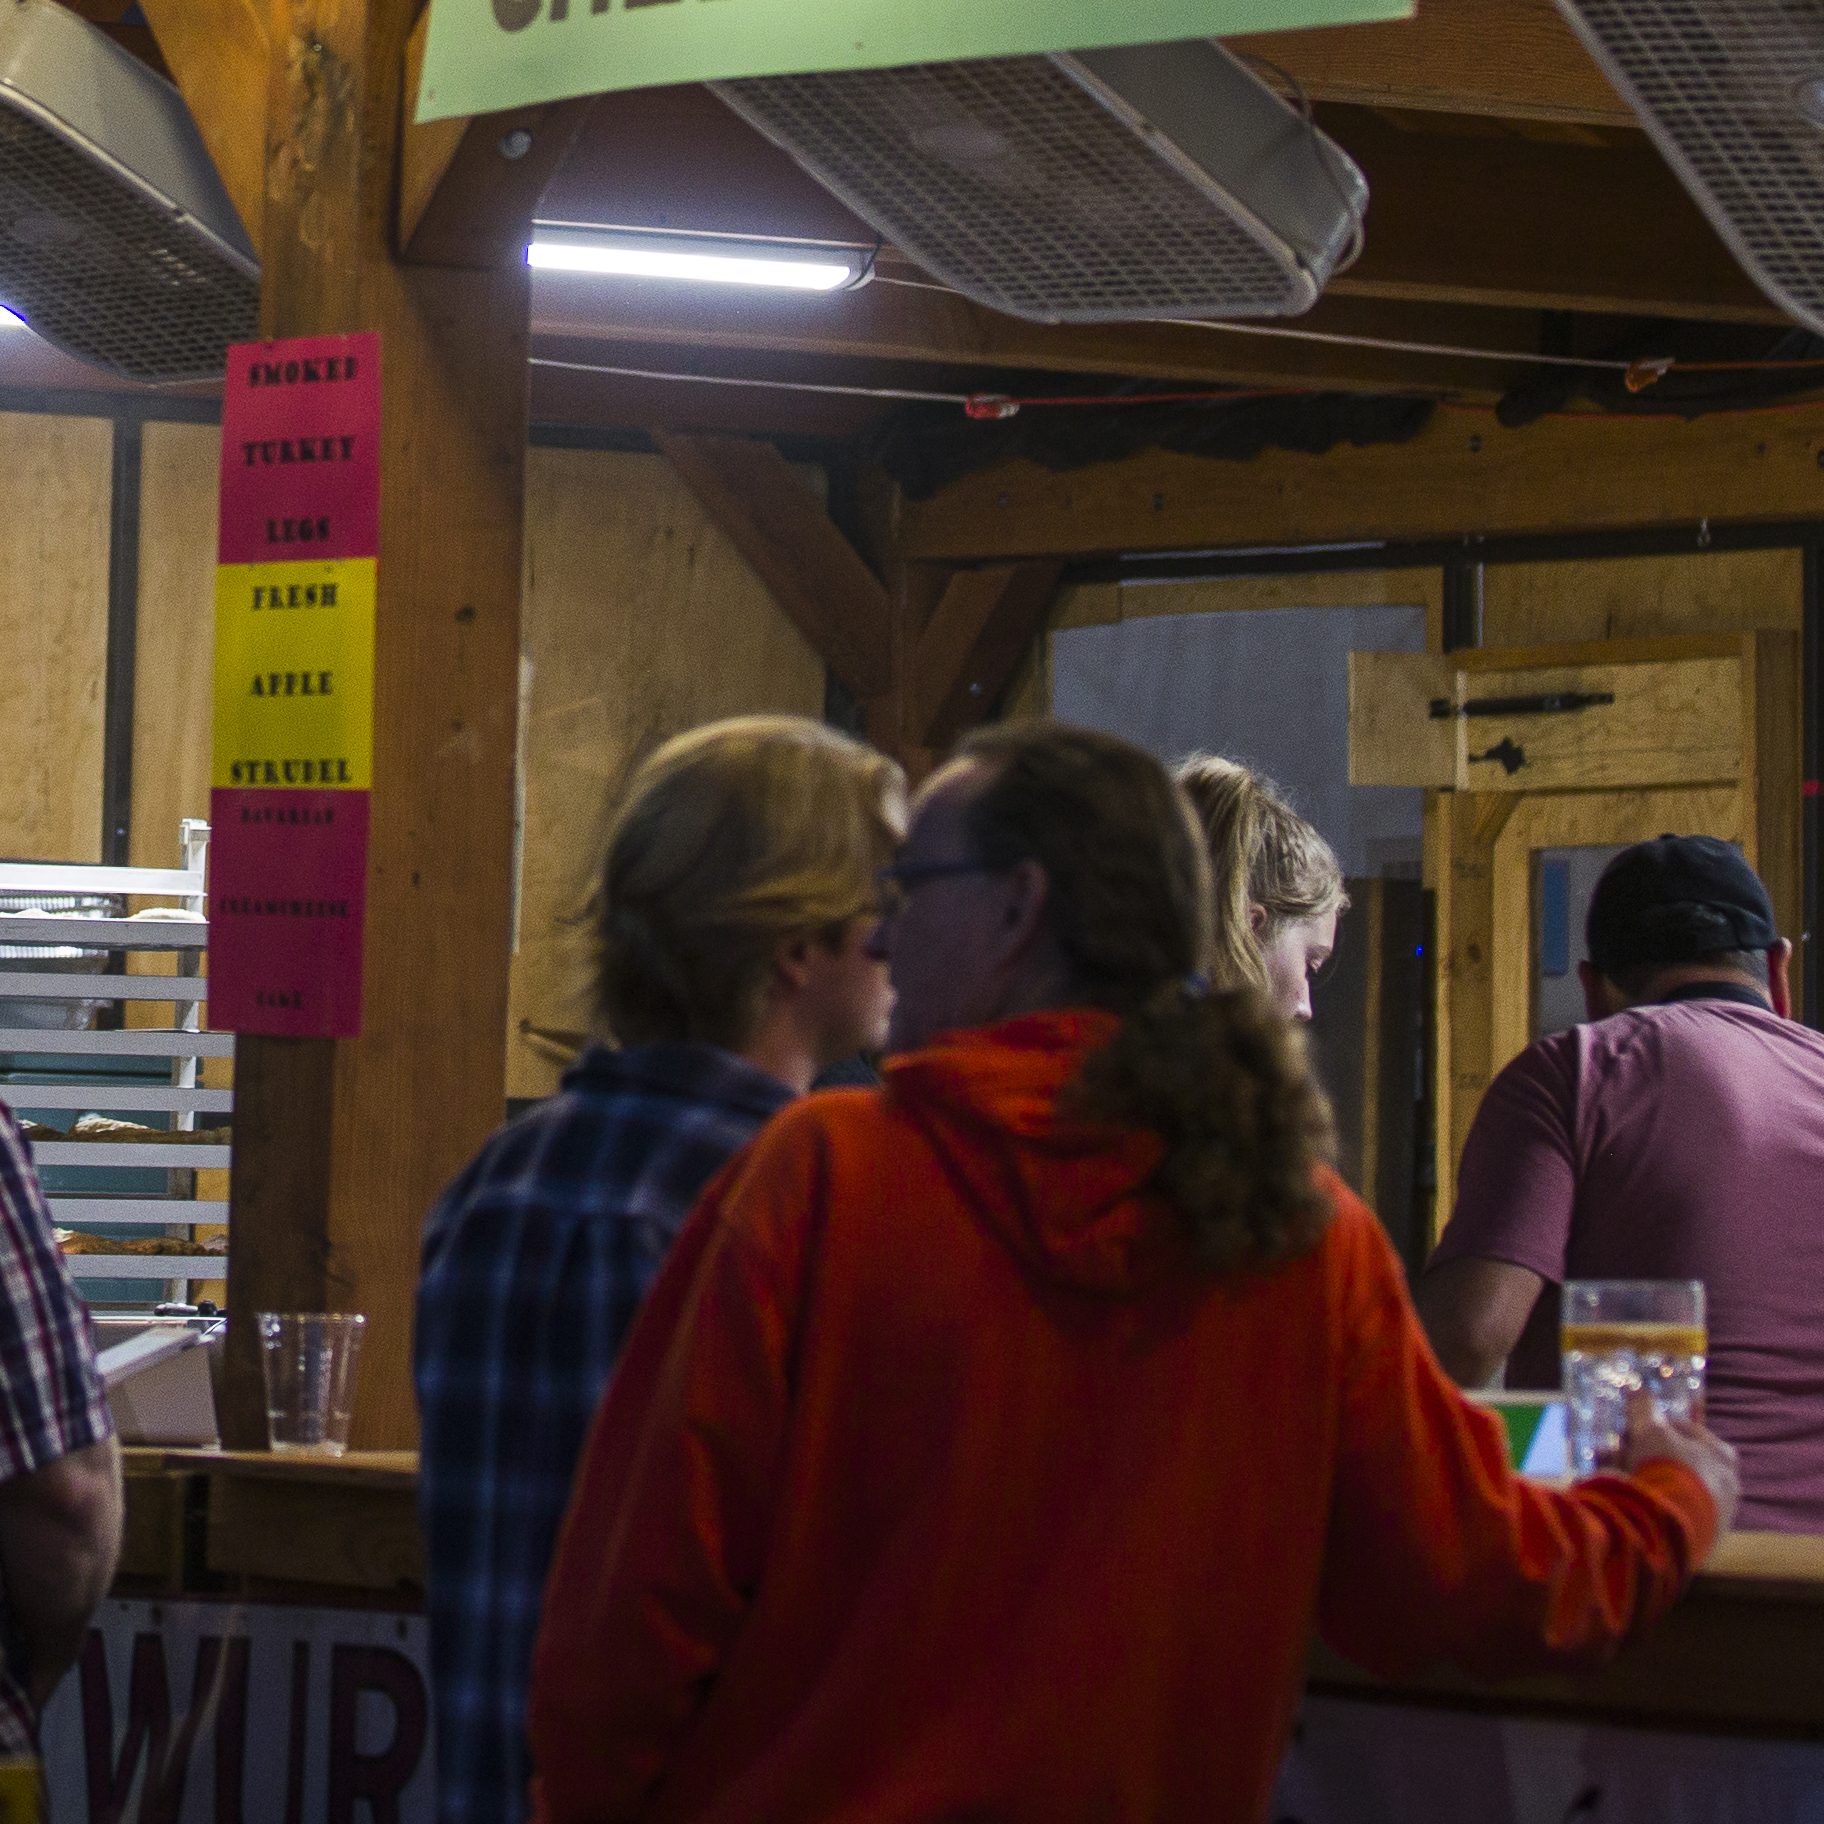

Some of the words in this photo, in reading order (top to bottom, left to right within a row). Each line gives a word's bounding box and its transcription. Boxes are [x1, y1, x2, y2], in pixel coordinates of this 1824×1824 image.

[242, 436, 355, 466] TURKEY
[252, 583, 338, 611] FRESH
[251, 672, 333, 697] APPLE
[231, 758, 351, 784] STRUDEL
